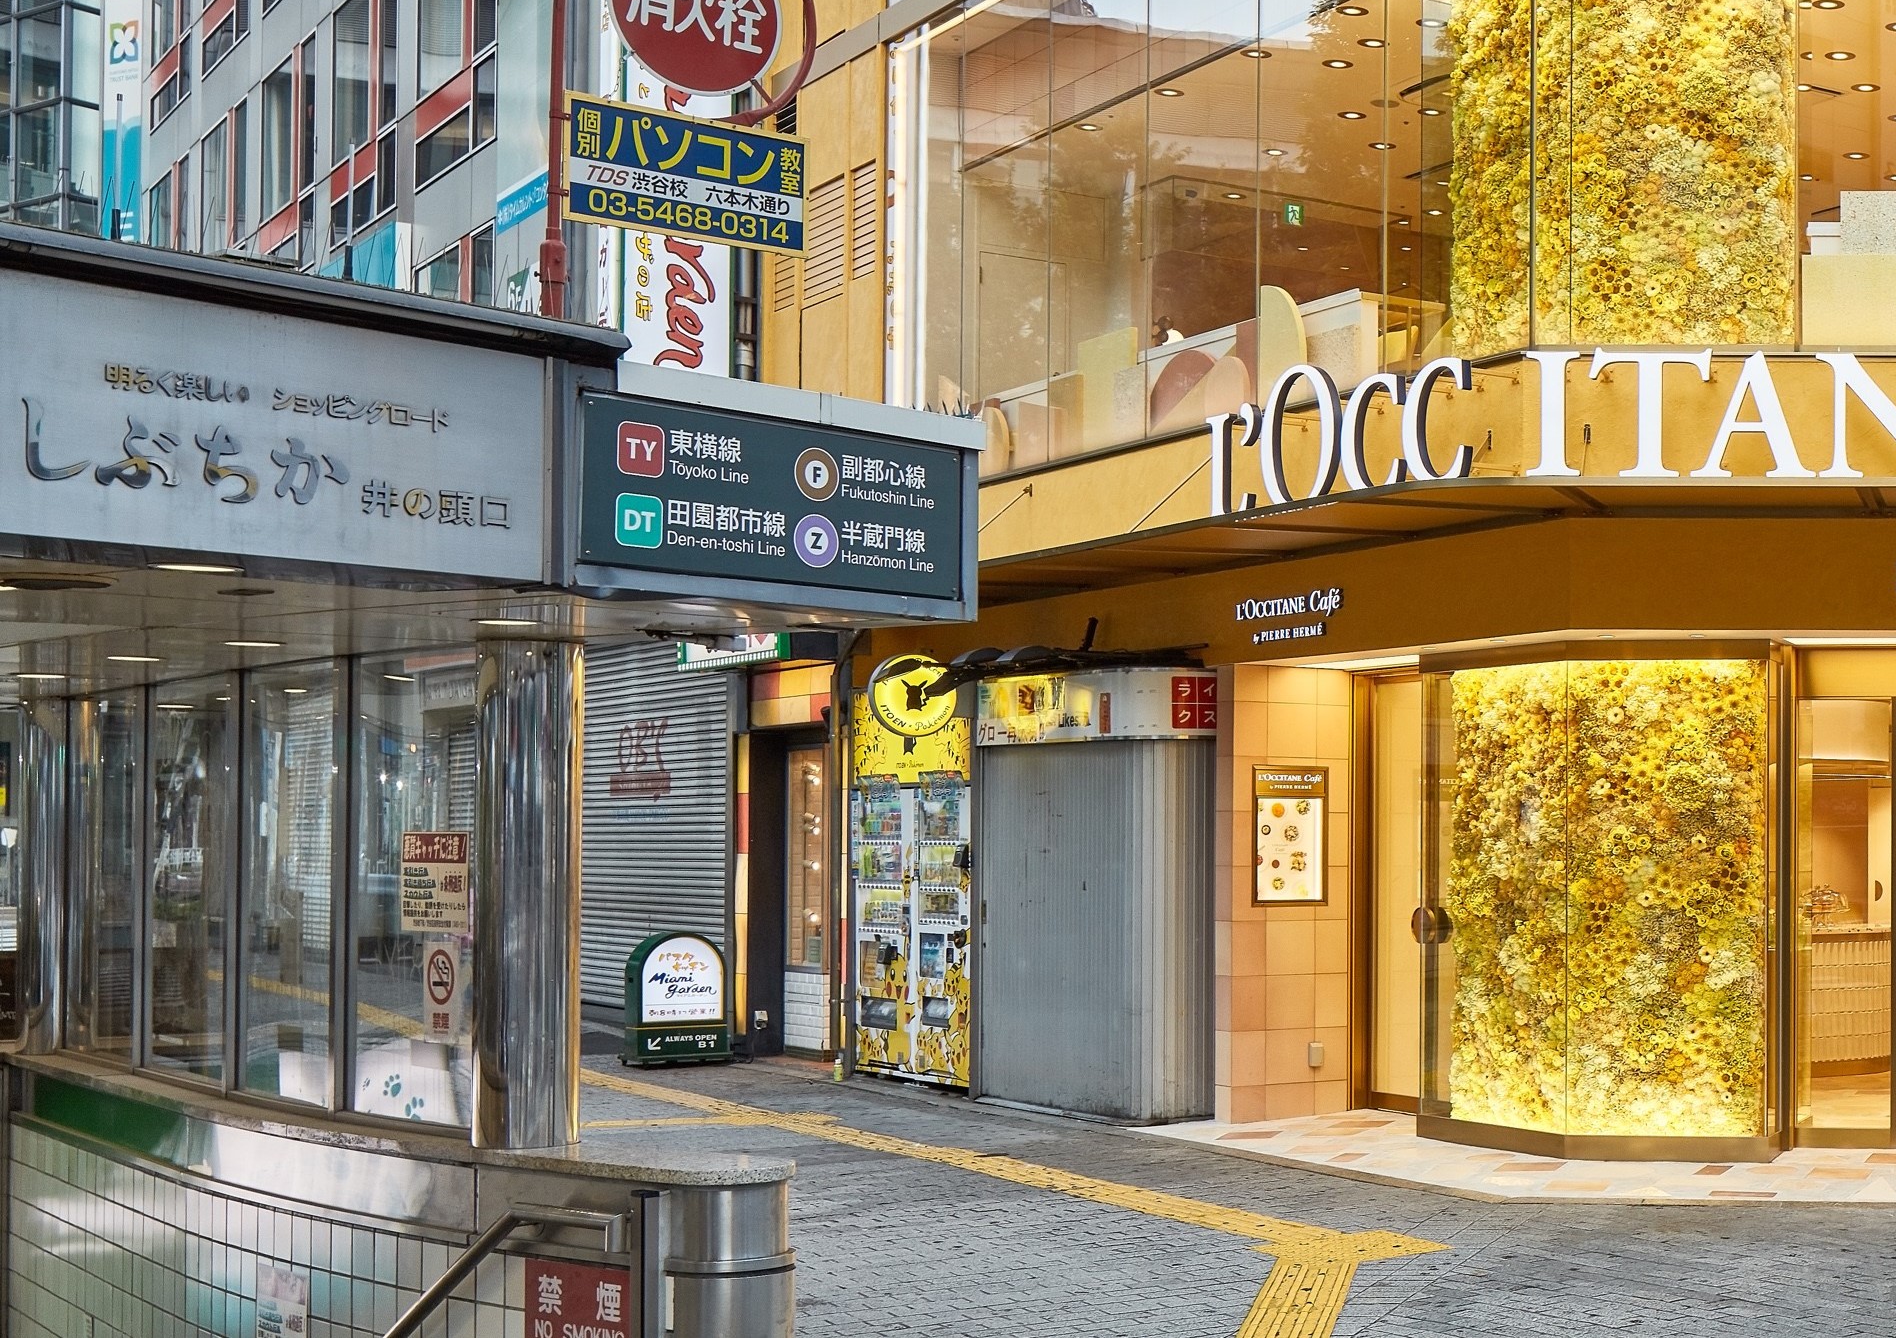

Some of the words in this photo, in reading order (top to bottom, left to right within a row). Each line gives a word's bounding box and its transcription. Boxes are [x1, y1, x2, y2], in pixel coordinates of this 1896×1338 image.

[577, 107, 601, 159] 個別
[605, 116, 775, 187] パソコン
[780, 146, 802, 196] 教室
[586, 164, 629, 186] TDS
[631, 170, 689, 200] 渋谷校
[705, 185, 792, 216] 六本木通り
[588, 190, 790, 244] 03-5468-0314
[104, 362, 249, 404] 明るく楽しい
[272, 388, 450, 433] ショッピングロード
[22, 396, 351, 506] しぶちか
[361, 478, 513, 529] 井の頭口
[626, 437, 657, 463] TY
[669, 429, 742, 463] 東横線
[721, 468, 749, 484] Line
[812, 466, 822, 484] F
[841, 454, 926, 490] 副都心線
[841, 484, 907, 506] Fukutoshin
[910, 494, 935, 510] Line
[624, 509, 656, 533] DT
[667, 500, 786, 538] 田園都市線
[667, 530, 754, 554] Den-en-toshi
[758, 540, 786, 558] Line
[810, 531, 823, 550] Z
[841, 520, 926, 553] 半蔵門線
[909, 558, 934, 573] Line
[1235, 595, 1306, 621] L'OCCITANE
[1309, 587, 1341, 617] Café
[1261, 628, 1291, 642] PIERRE
[1292, 623, 1323, 637] HERMÉ
[648, 972, 695, 985] Miami
[534, 1318, 553, 1338] NO
